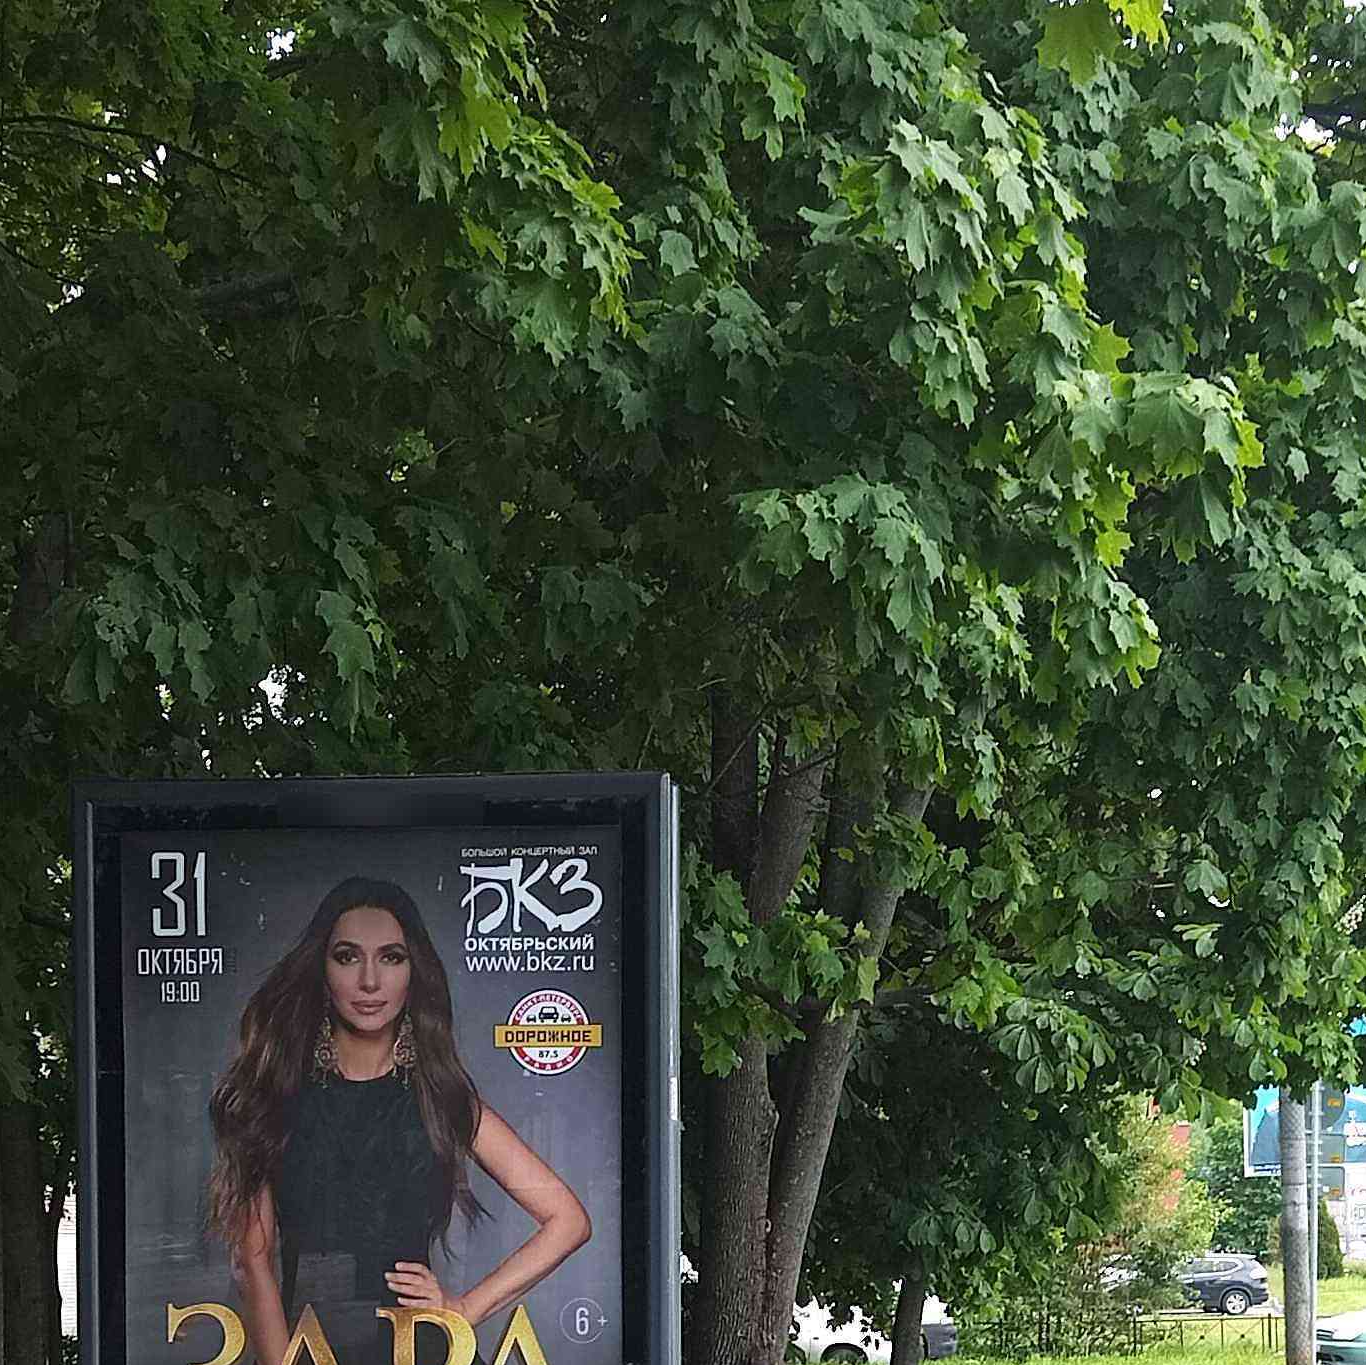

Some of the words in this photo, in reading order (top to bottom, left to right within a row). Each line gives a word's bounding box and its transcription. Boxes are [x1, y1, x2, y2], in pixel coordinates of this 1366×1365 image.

[461, 847, 507, 857] БОЛЬШОЙ
[511, 846, 575, 856] КОНЦЕРТНЫЙ
[578, 846, 598, 855] ЗАЛ
[151, 852, 206, 936] 31
[459, 858, 603, 937] БКЗ
[464, 934, 594, 951] ОКТЯБРЬСКИЙ
[137, 948, 223, 975] ОКТЯБРЯ
[465, 951, 594, 972] www.bkz.ru
[161, 982, 199, 1002] 19:00
[505, 1030, 592, 1042] ДОРОЖНОЕ
[538, 1050, 558, 1058] 87.5
